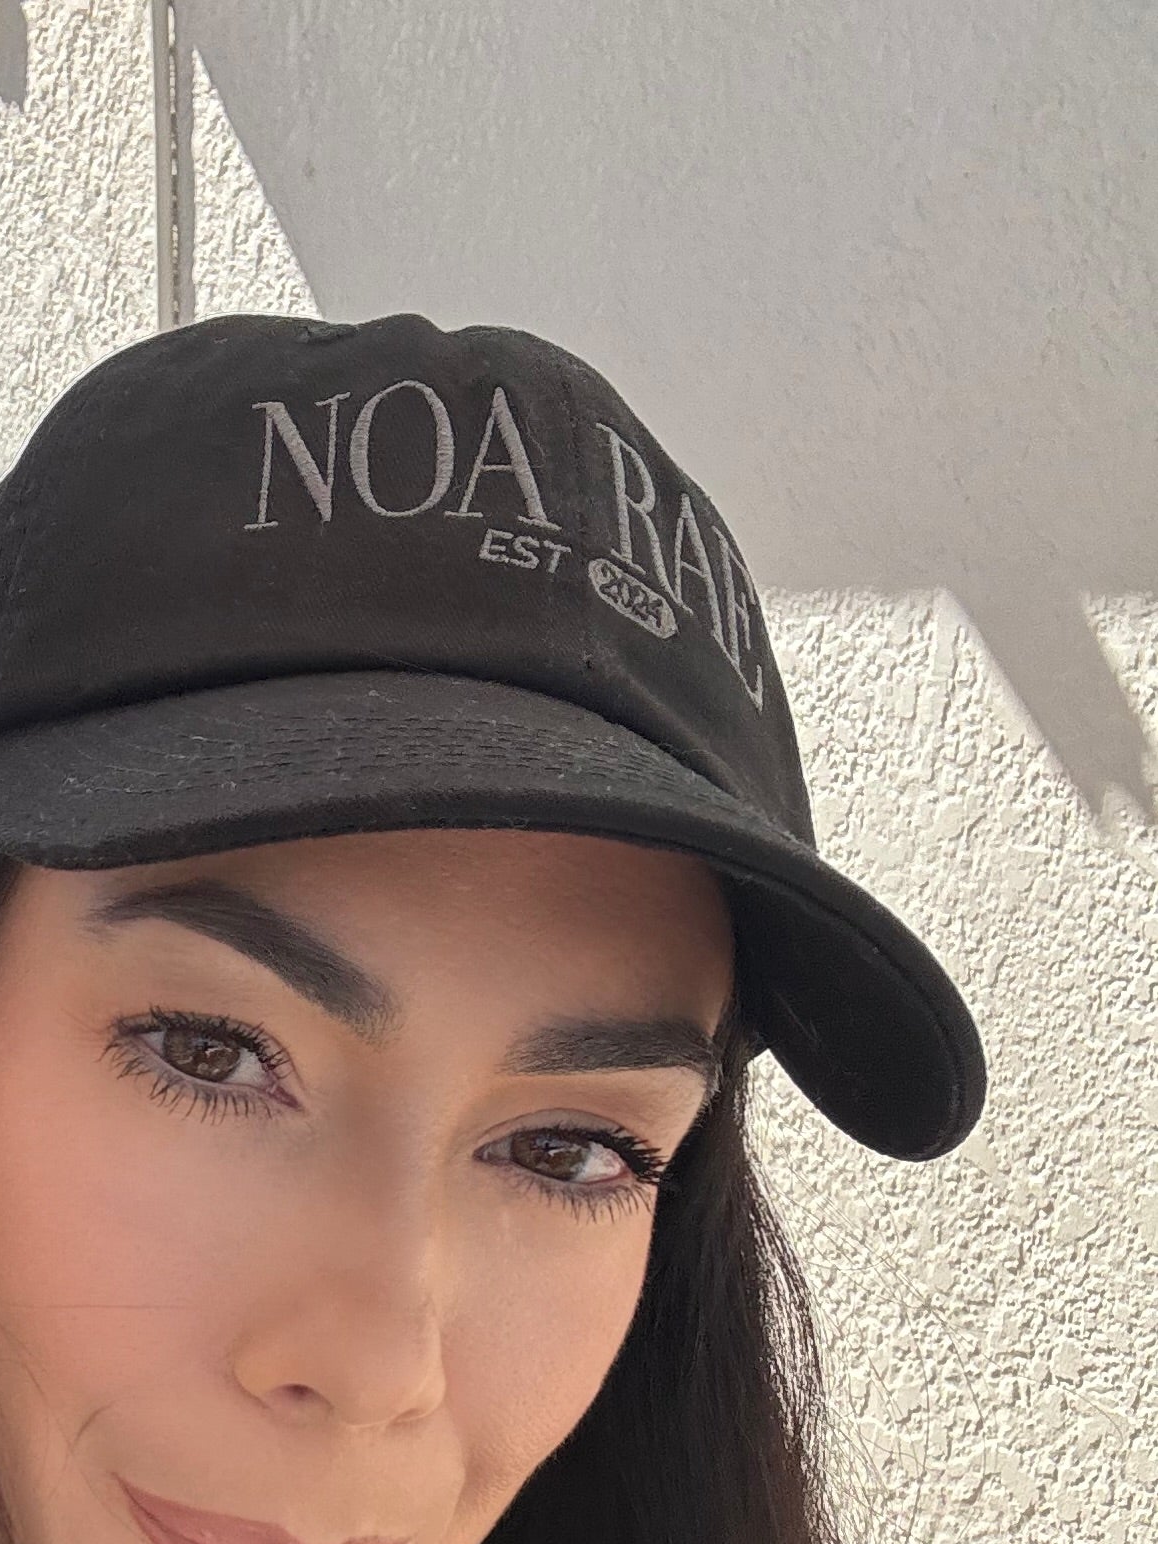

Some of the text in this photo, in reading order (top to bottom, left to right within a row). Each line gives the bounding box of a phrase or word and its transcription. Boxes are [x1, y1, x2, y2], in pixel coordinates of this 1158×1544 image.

[244, 379, 764, 713] NOA RAE
[478, 528, 572, 574] EST
